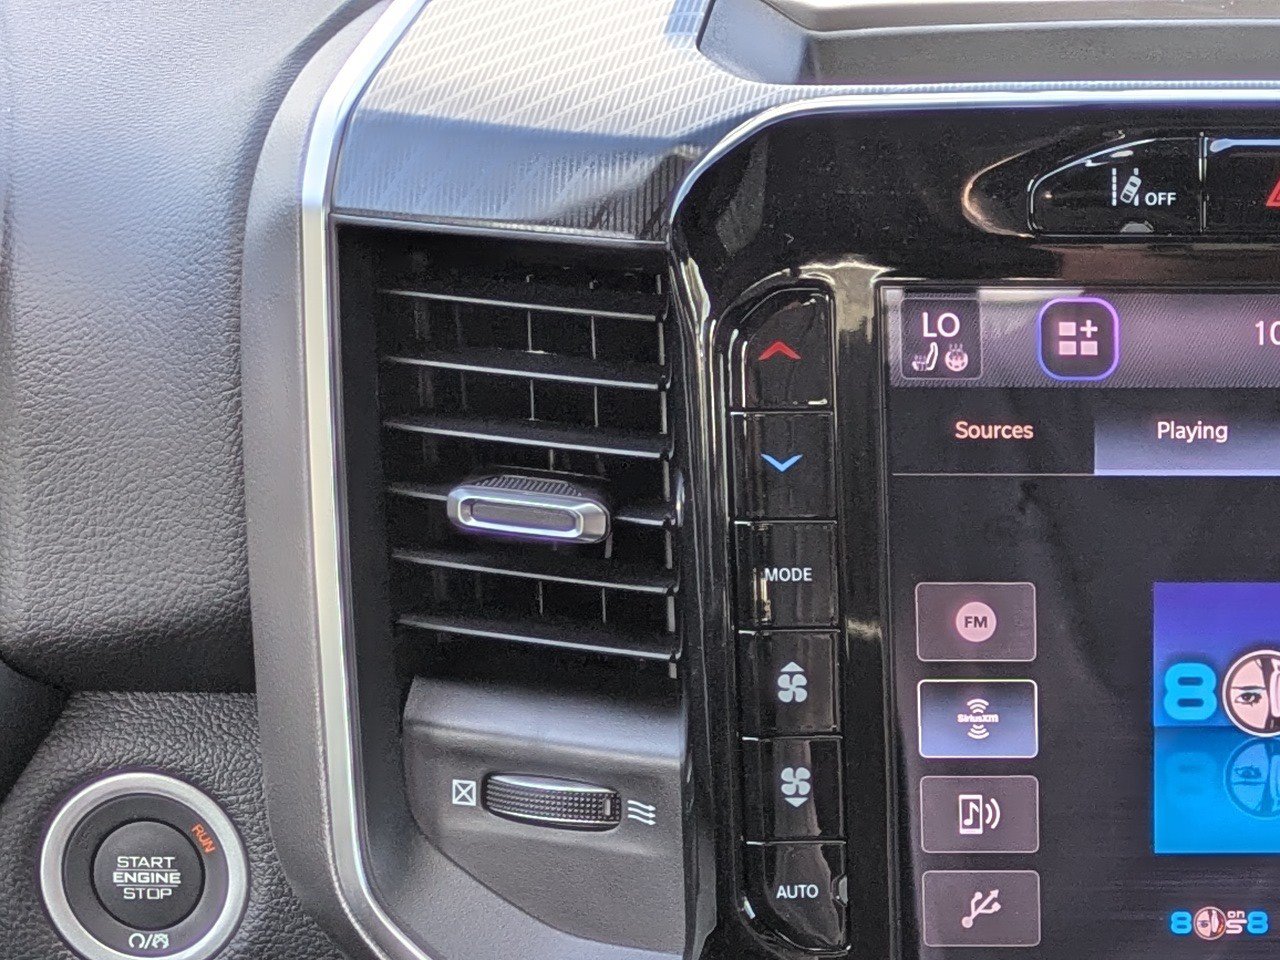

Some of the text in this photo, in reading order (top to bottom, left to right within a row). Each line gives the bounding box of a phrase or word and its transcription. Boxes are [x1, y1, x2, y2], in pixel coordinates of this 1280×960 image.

[1145, 192, 1176, 206] OFF
[921, 313, 960, 338] LO
[954, 420, 1034, 441] Sources
[1156, 420, 1229, 447] Playing
[764, 567, 813, 582] MODE
[963, 615, 988, 629] FM
[191, 823, 216, 854] RUN
[117, 856, 175, 869] START
[112, 871, 182, 885] ENGINE
[123, 887, 172, 900] STOP
[776, 884, 819, 900] AUTO
[1246, 911, 1270, 935] 8
